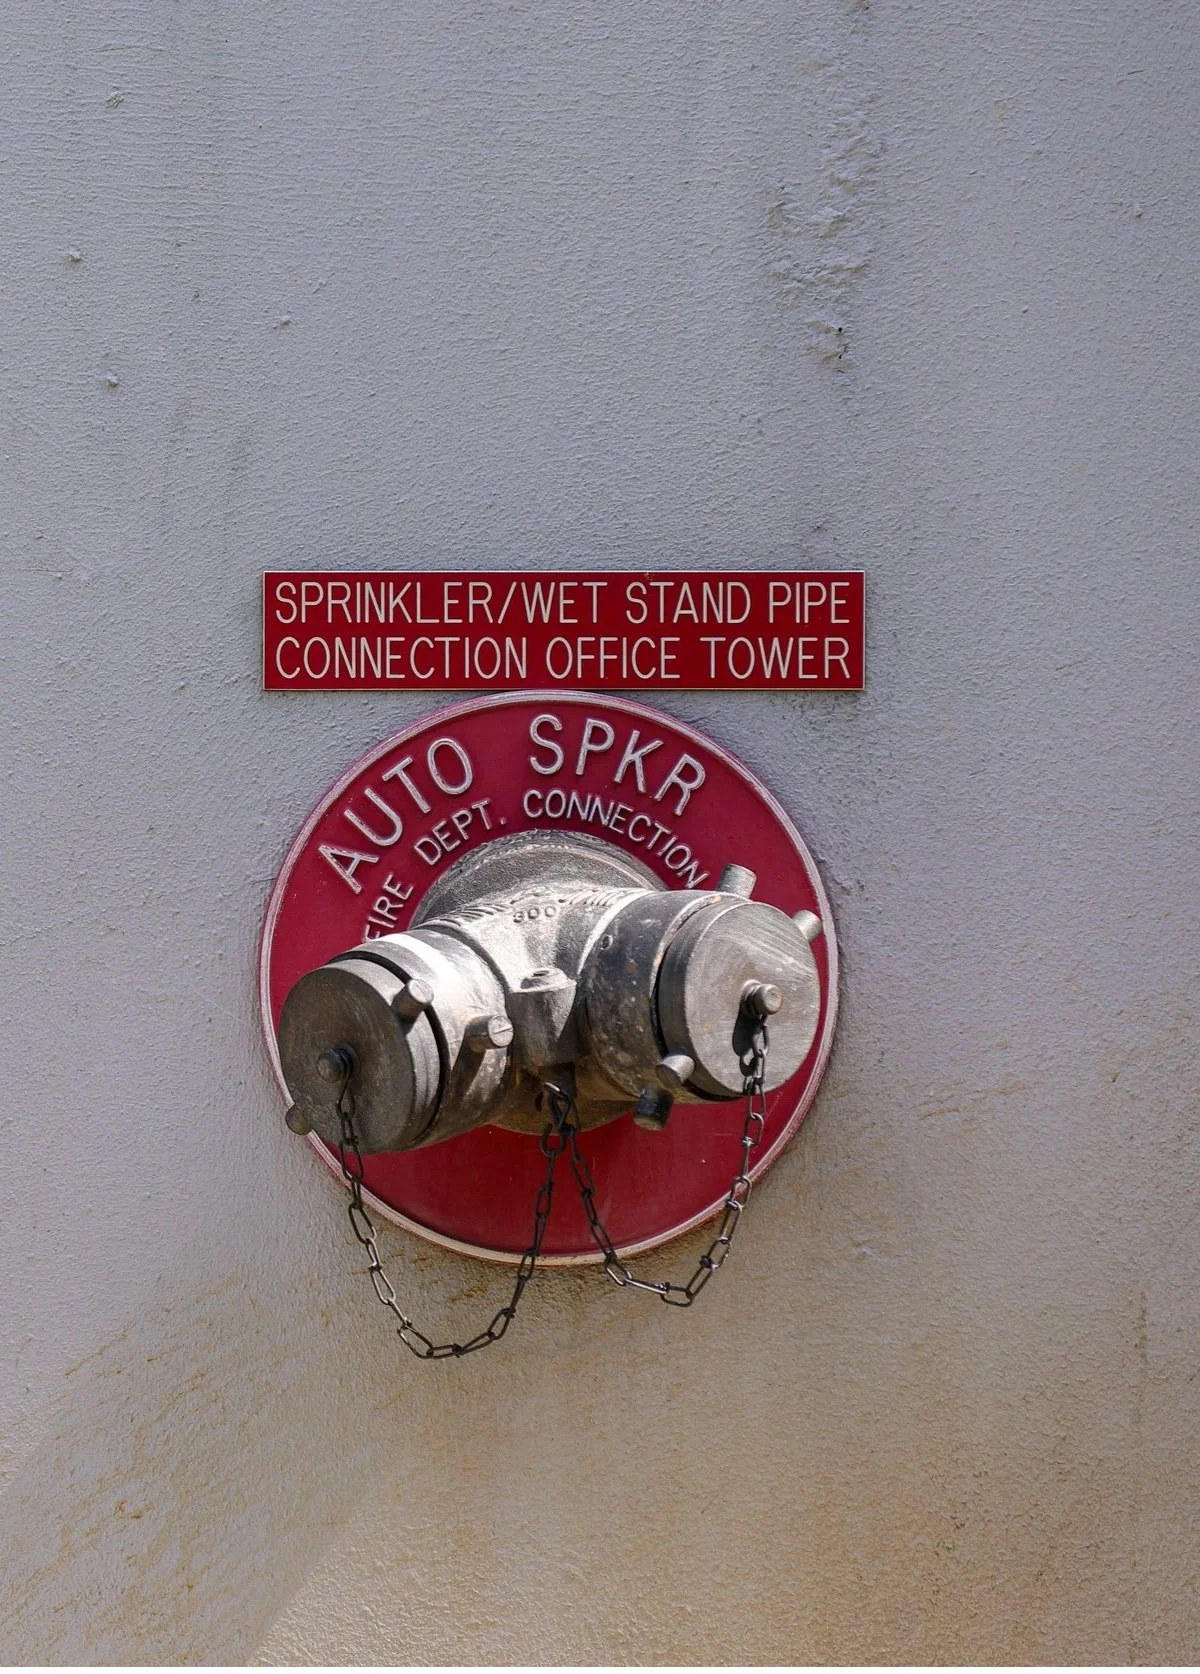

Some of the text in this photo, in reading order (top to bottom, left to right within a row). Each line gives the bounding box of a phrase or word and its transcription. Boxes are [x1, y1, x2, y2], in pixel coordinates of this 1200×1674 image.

[275, 581, 850, 624] SPRINKLER/WET STAND PIPE
[275, 636, 851, 680] CONNECTION OFFICE TOWER
[317, 713, 706, 895] AUTO SPKR
[362, 788, 710, 943] FIRE DEPT. CONNECTION
